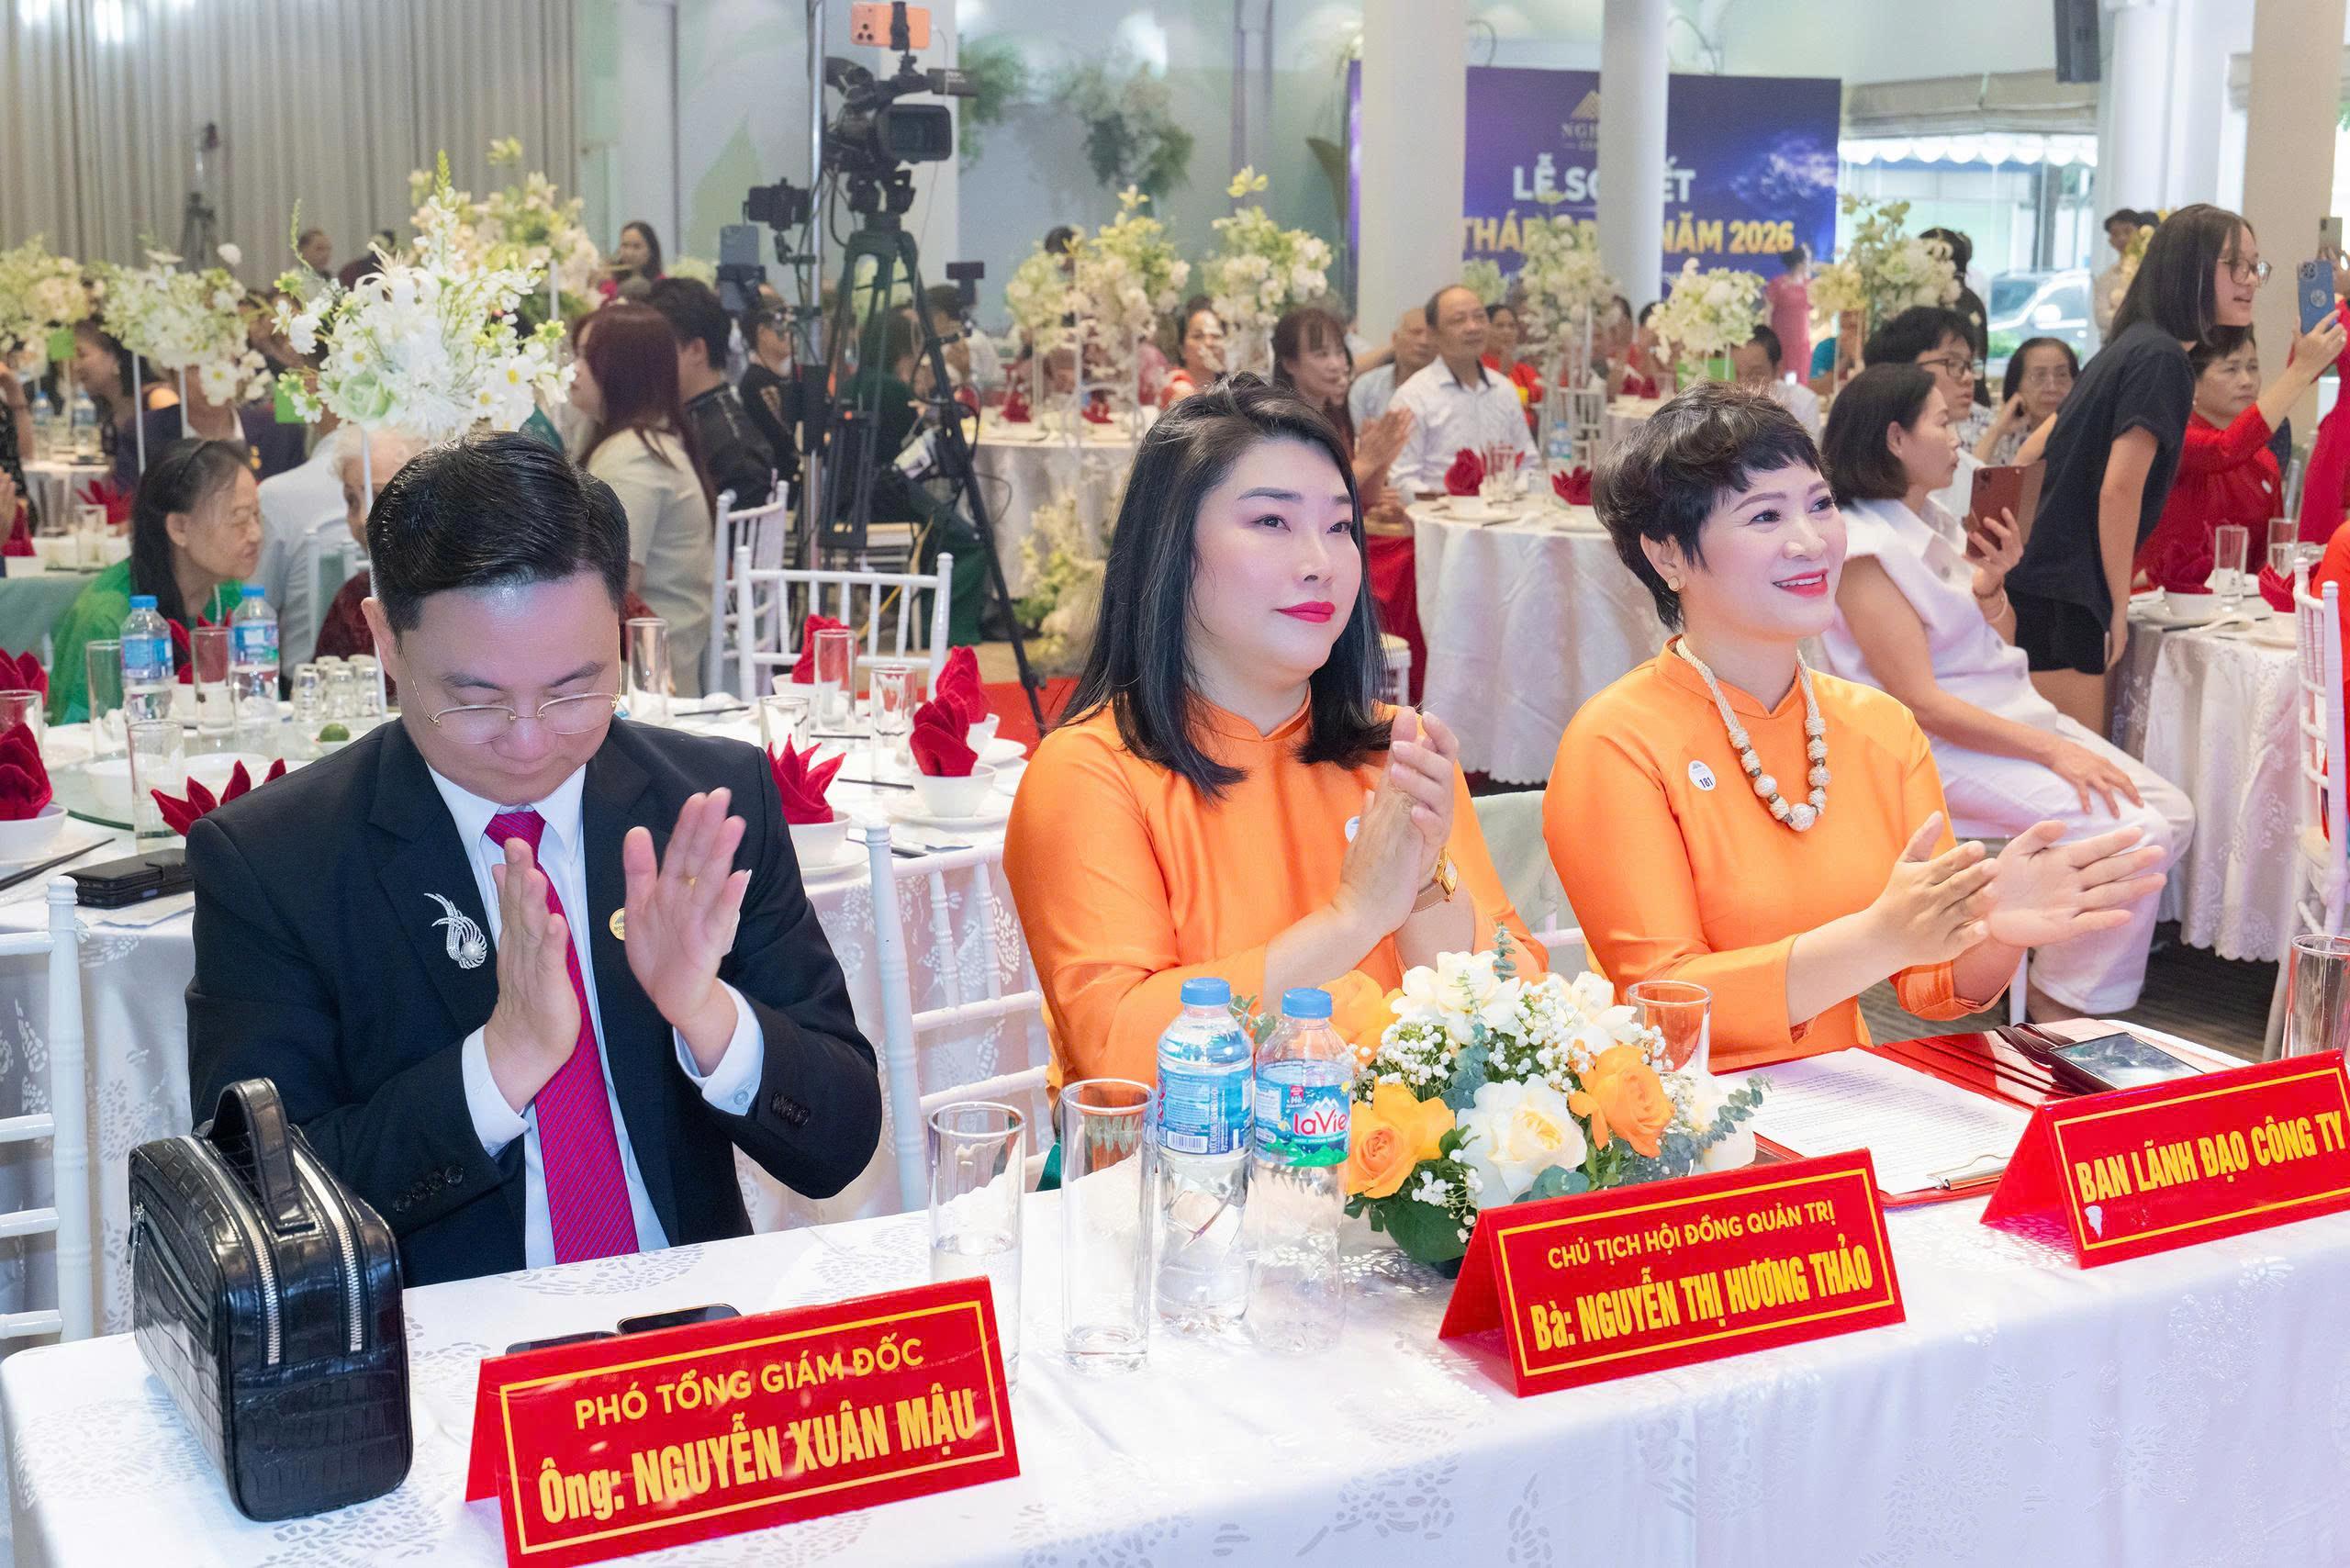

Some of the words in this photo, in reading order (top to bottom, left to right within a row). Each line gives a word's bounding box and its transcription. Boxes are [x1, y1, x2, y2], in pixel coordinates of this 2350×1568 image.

[1729, 220, 1795, 253] 2026
[1699, 777, 1713, 788] 181
[1293, 1109, 1347, 1135] laVie
[2075, 1154, 2132, 1204] BAN
[2132, 1139, 2199, 1193] LÃNH
[2198, 1130, 2250, 1183] ĐẠO
[2251, 1115, 2318, 1167] CÔNG
[2315, 1110, 2346, 1153] TY
[1548, 1237, 1591, 1269] CHỦ
[1593, 1234, 1641, 1265] TỊCH
[1645, 1222, 1681, 1255] HỘI
[1684, 1214, 1743, 1245] ĐỒNG
[1747, 1201, 1803, 1234] QUẢN
[1805, 1200, 1836, 1226] TRỊ
[1529, 1300, 1576, 1351] Bà:
[1575, 1267, 1681, 1342] NGUYỄN
[1679, 1272, 1727, 1327] THỊ
[1723, 1256, 1811, 1315] HƯƠNG
[1808, 1233, 1874, 1297] THẢO
[575, 1380, 648, 1429] PHÓ
[655, 1368, 752, 1414] TỔNG
[760, 1349, 845, 1393] GIÁM
[852, 1332, 925, 1377] ĐỐC
[539, 1457, 625, 1524] Ông:
[631, 1411, 783, 1506] NGUYỄN
[788, 1400, 890, 1474] XUÂN
[895, 1382, 979, 1456] MẬU
